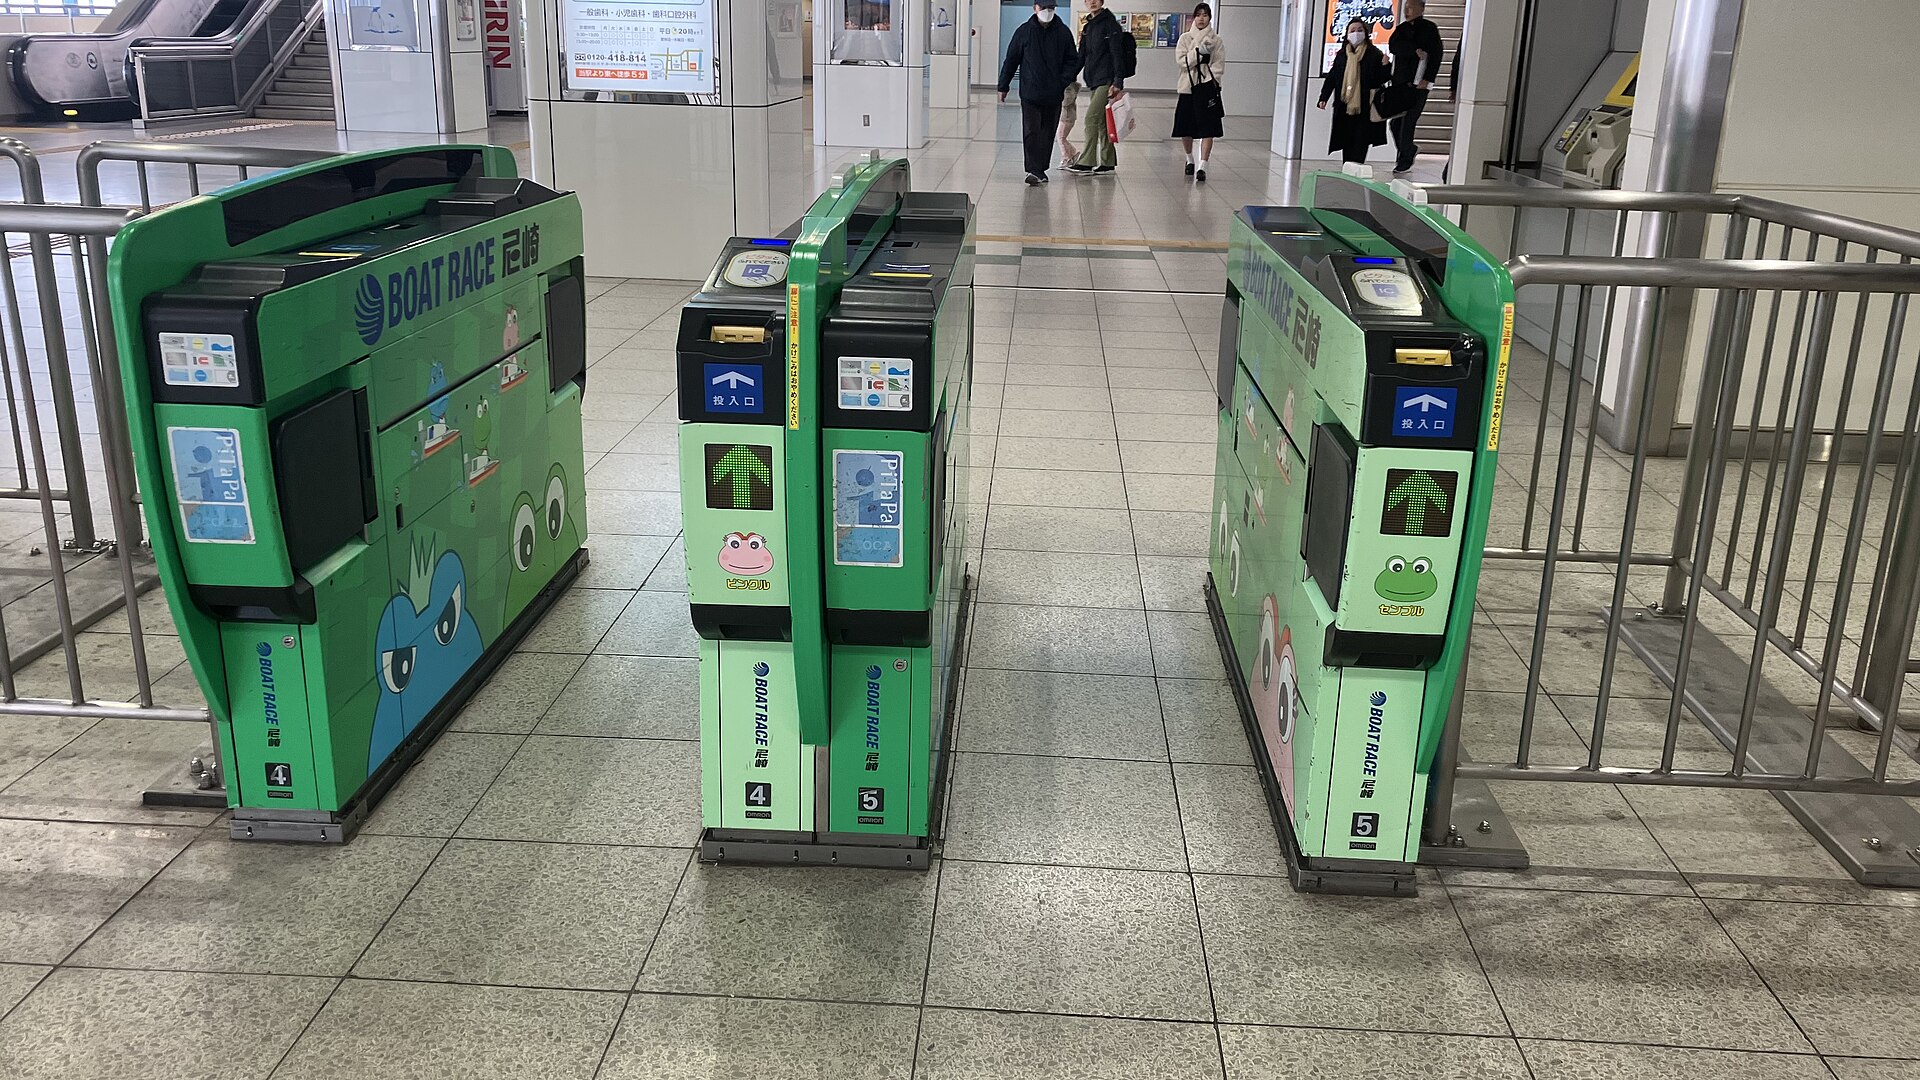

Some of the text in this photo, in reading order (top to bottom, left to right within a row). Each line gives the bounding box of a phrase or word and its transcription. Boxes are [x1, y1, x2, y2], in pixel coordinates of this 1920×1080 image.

[586, 53, 647, 63] 0120-418-814
[388, 222, 540, 329] BOAT RACE 尼崎
[1270, 274, 1295, 338] RACE
[1291, 295, 1322, 370] 尼崎
[712, 395, 755, 407] 投入口
[1401, 418, 1445, 430] 投入口
[215, 435, 240, 501] PiTaPa
[880, 457, 899, 524] PiTaPa
[1378, 603, 1425, 616] センプル
[259, 658, 275, 691] BOAT
[264, 692, 279, 725] RACE
[755, 679, 768, 712] BOAT
[867, 682, 880, 715] BOAT
[755, 713, 768, 746] RACE
[866, 716, 879, 749] RACE
[1369, 709, 1383, 741] BOAT
[270, 763, 289, 786] 4
[1364, 743, 1379, 776] RACE
[749, 785, 766, 805] 4
[859, 788, 879, 811] 5
[1356, 814, 1374, 836] 5
